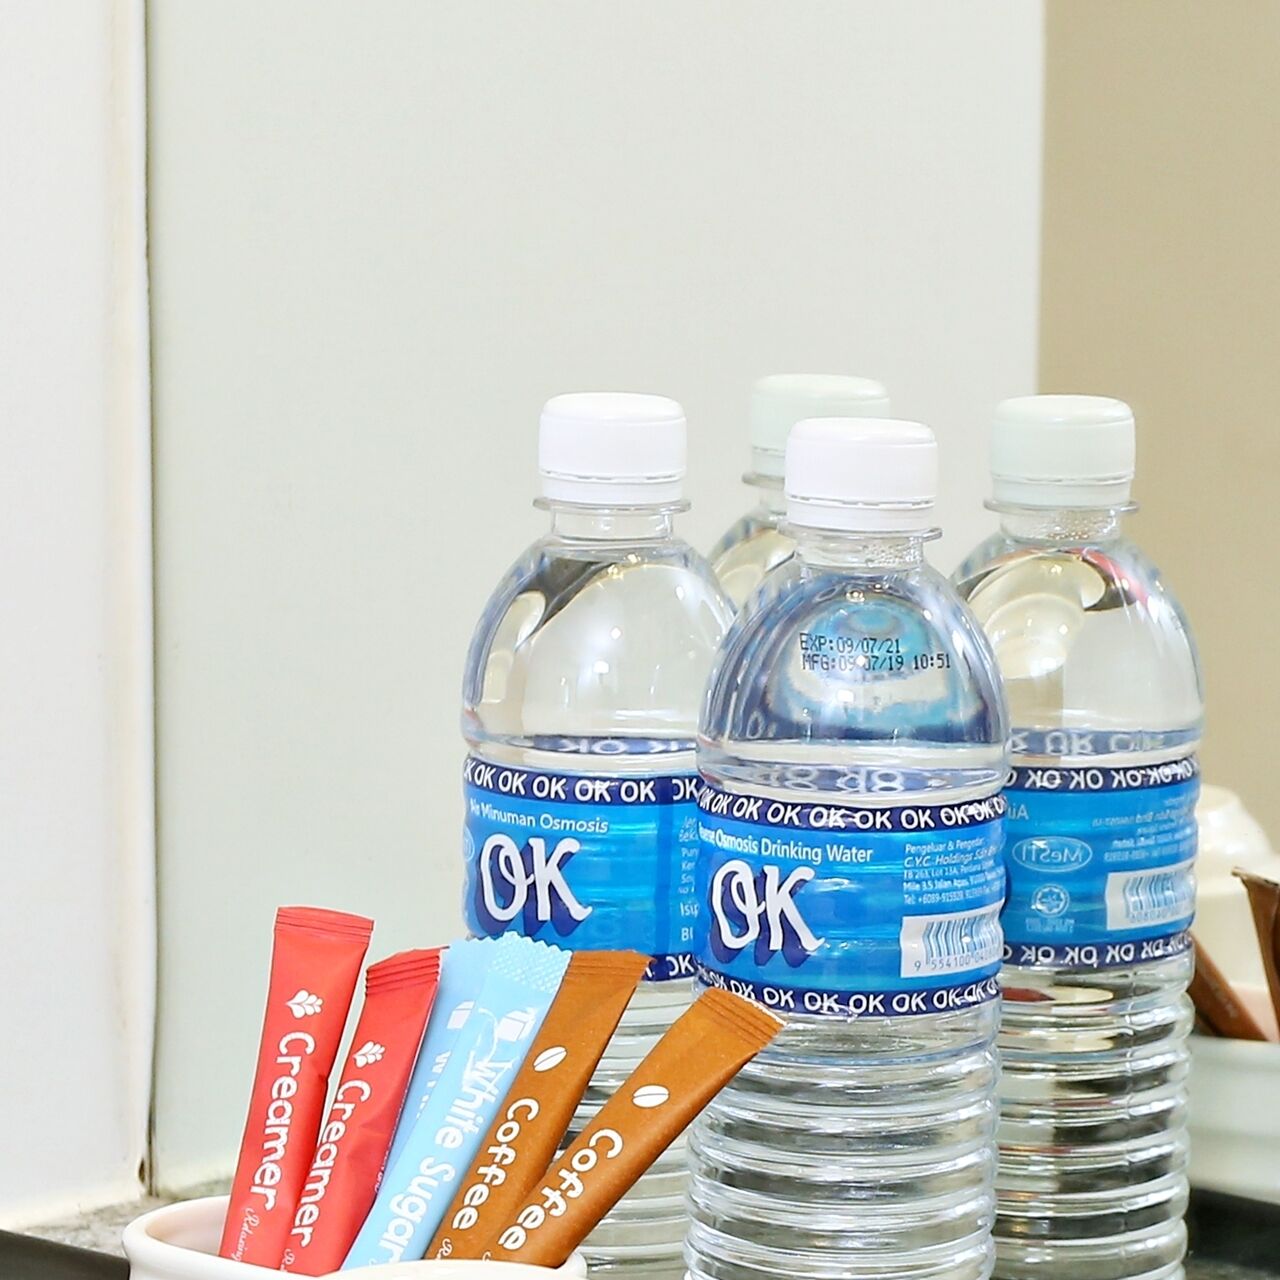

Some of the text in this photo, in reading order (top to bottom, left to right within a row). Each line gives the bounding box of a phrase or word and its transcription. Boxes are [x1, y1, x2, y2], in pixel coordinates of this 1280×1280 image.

[799, 633, 900, 655] EXP:09/07/21
[913, 653, 951, 670] 10:51
[474, 764, 497, 789] OK
[498, 770, 528, 795] OK
[532, 775, 567, 800] OK
[574, 779, 612, 802] OK
[620, 780, 657, 802] OK
[481, 802, 536, 828] Minuman
[540, 812, 609, 833] Osmosis
[711, 793, 733, 815] OK
[733, 797, 763, 821] OK
[766, 802, 802, 826] OK
[809, 806, 846, 829] OK
[855, 810, 892, 830] OK
[900, 808, 935, 829] OK
[940, 807, 970, 826] OK
[479, 832, 593, 930] OK
[716, 828, 760, 856] Osmosis
[761, 838, 822, 865] Drinking
[826, 843, 874, 863] Water
[710, 859, 825, 960] OK
[763, 988, 795, 1009] OK
[804, 992, 839, 1013] OK
[848, 994, 885, 1013] OK
[892, 992, 927, 1013] OK
[933, 988, 962, 1008] OK
[964, 981, 987, 1003] OK
[248, 1031, 316, 1212] Creamer
[435, 1056, 502, 1149] White
[289, 1079, 371, 1248] Creamer
[379, 1157, 456, 1262] Sugar
[452, 1097, 540, 1231] Coffee
[497, 1127, 623, 1252] Coffee
